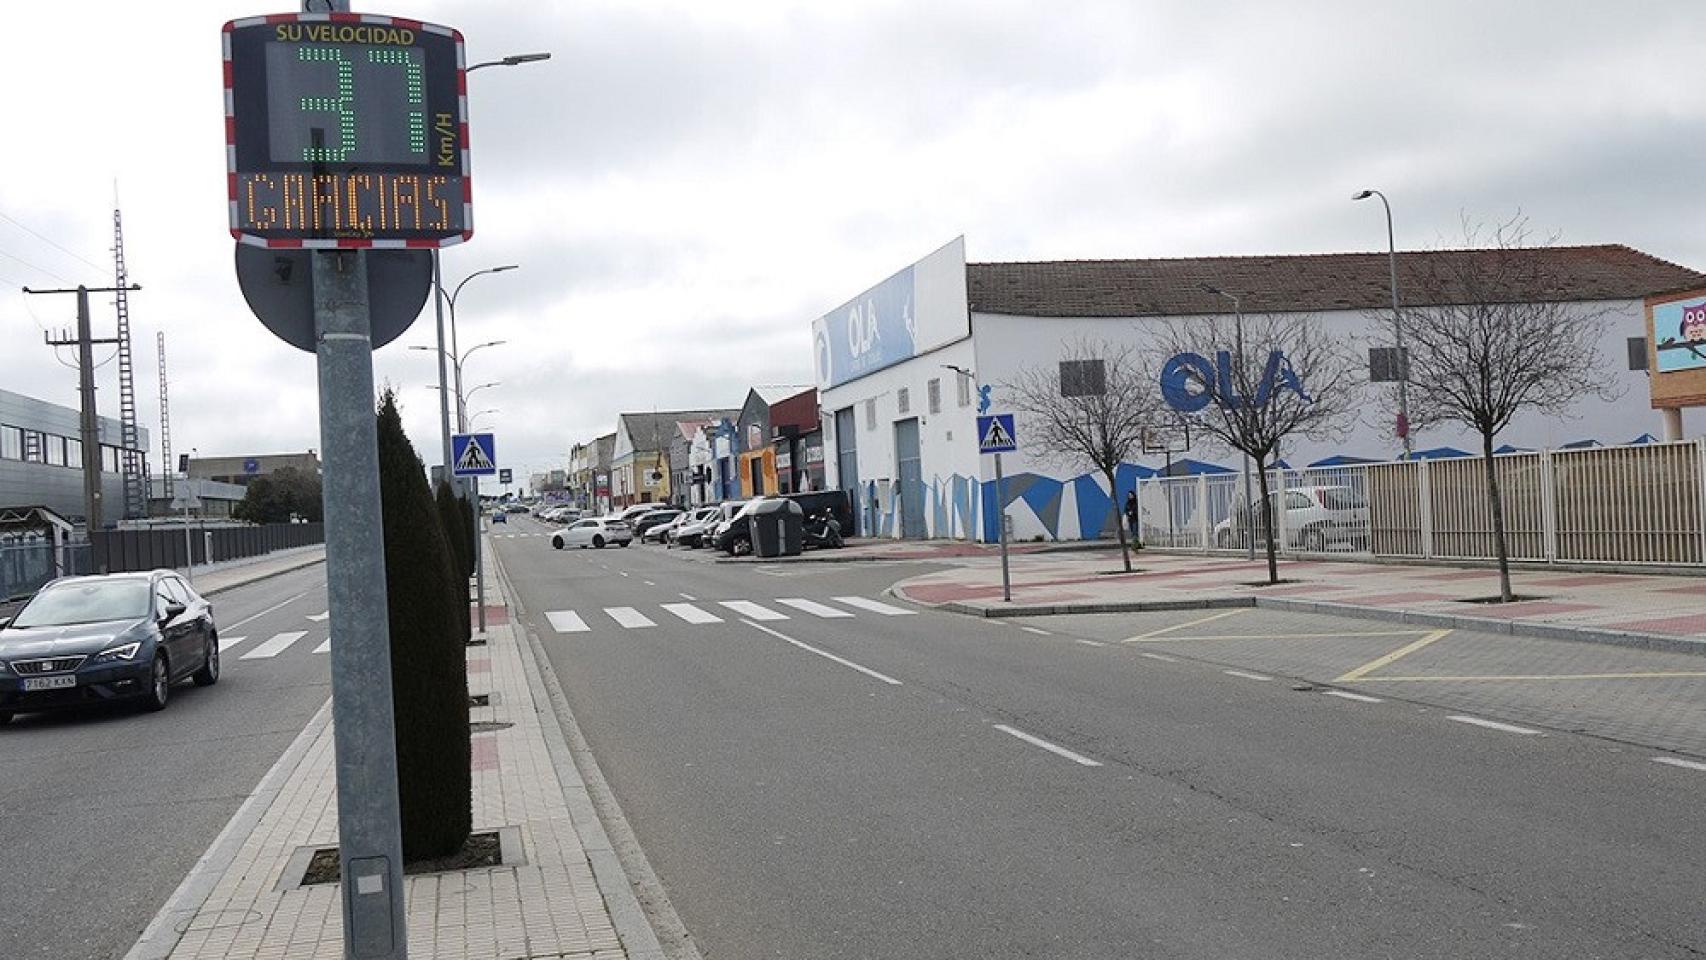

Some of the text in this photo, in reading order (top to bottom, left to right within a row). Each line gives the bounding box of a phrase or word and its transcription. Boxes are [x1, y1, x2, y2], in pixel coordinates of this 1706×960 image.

[276, 25, 414, 46] SU VELOCIDAD
[299, 47, 424, 162] 37
[436, 113, 455, 167] Km/H
[848, 298, 881, 359] OLA
[1160, 350, 1314, 413] OLA
